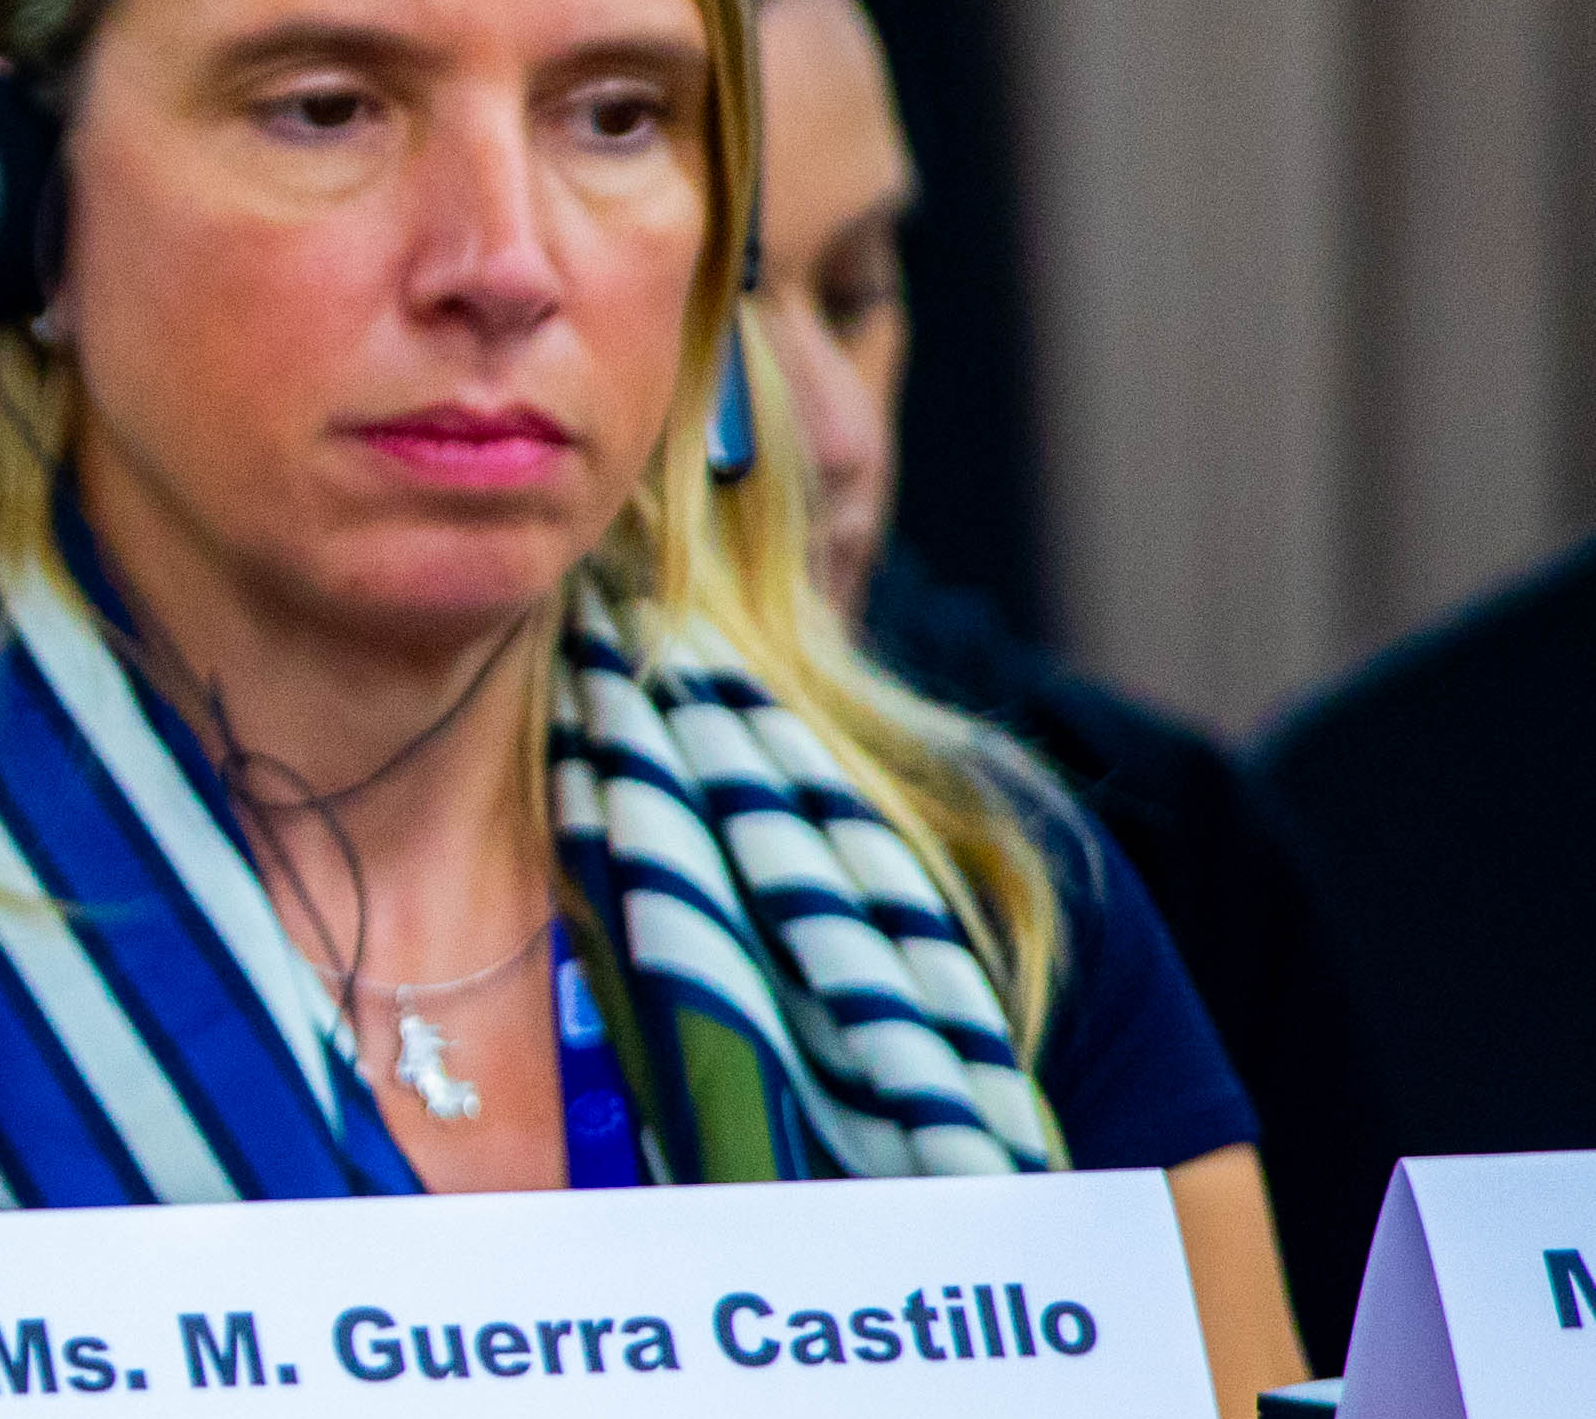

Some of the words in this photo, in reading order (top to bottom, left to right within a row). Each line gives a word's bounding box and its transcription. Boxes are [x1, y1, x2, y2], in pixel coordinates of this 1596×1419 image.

[178, 1311, 300, 1389] M.
[332, 1306, 682, 1384] Guerra
[712, 1282, 1099, 1369] Castillo
